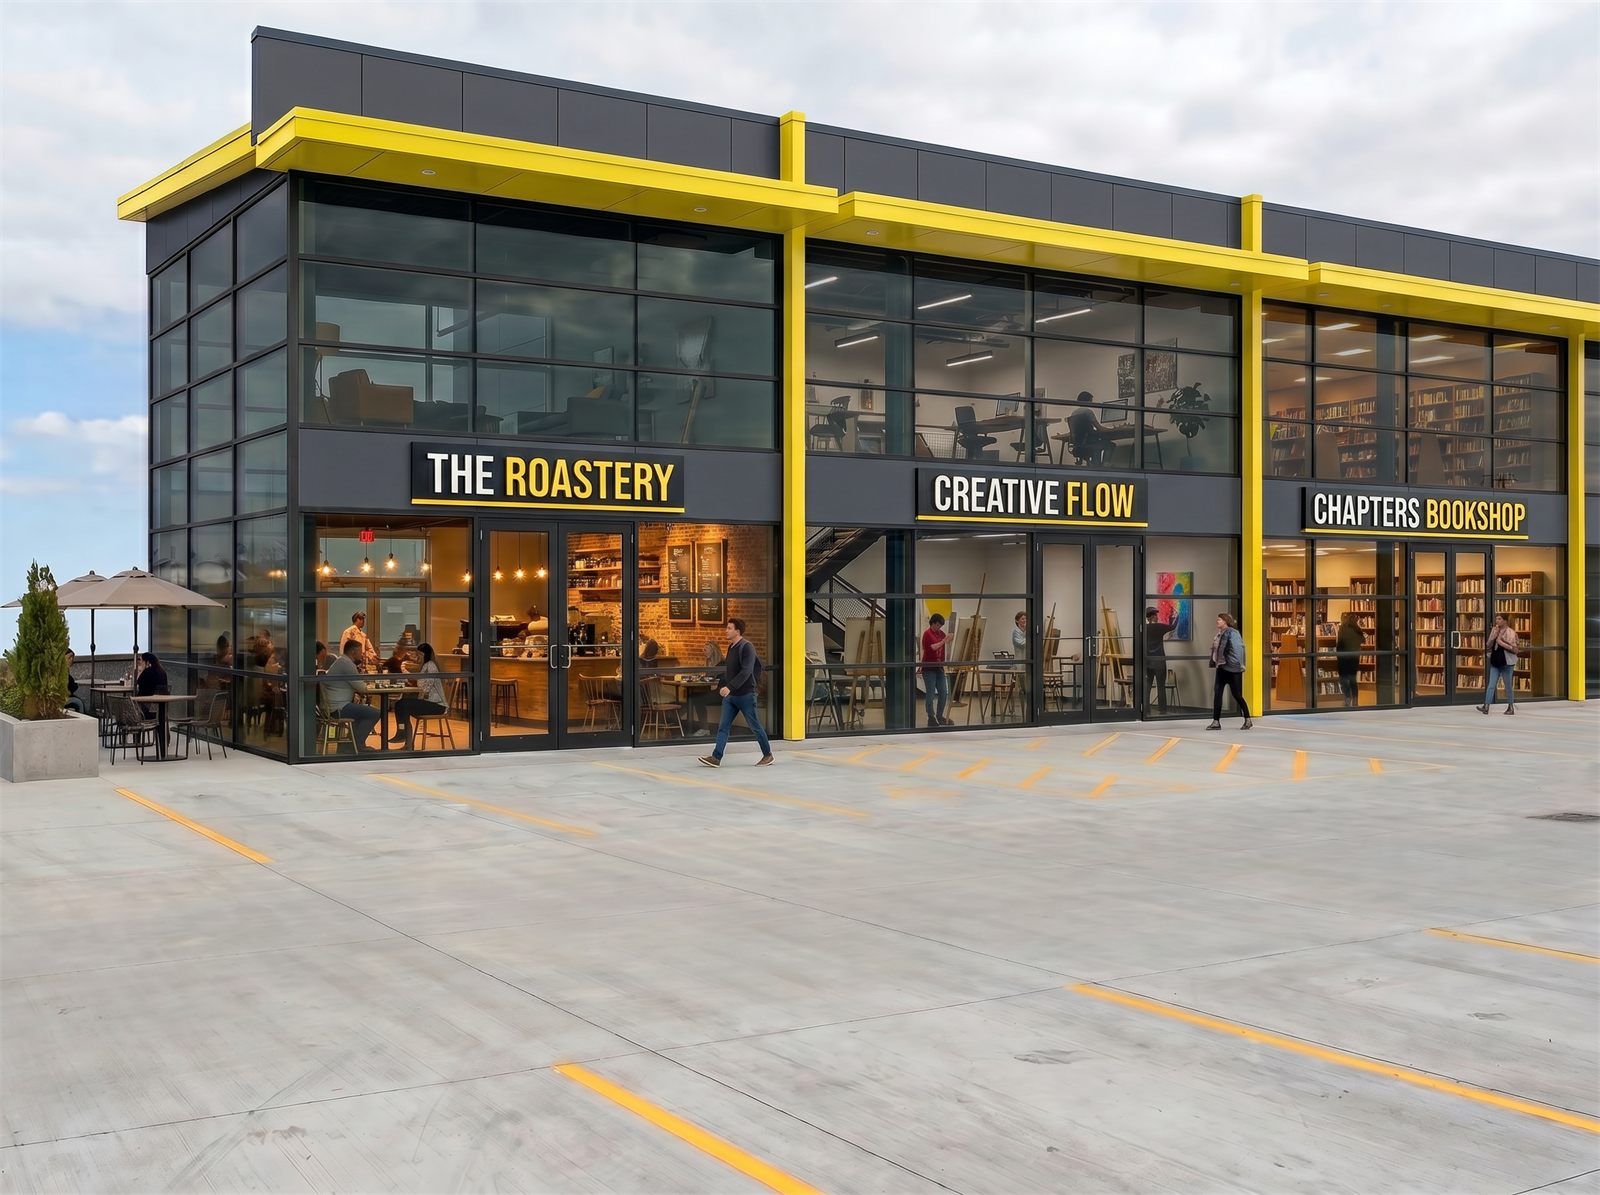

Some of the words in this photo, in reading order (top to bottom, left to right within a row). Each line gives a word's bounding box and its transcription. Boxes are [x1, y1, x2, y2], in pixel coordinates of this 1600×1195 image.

[427, 452, 494, 495] THE
[506, 456, 674, 501] ROASTERY
[934, 474, 1059, 515] CREATIVE
[1066, 481, 1135, 518] FLOW
[1313, 493, 1420, 529] CHAPTERS
[1426, 498, 1526, 532] BOOKSHOP
